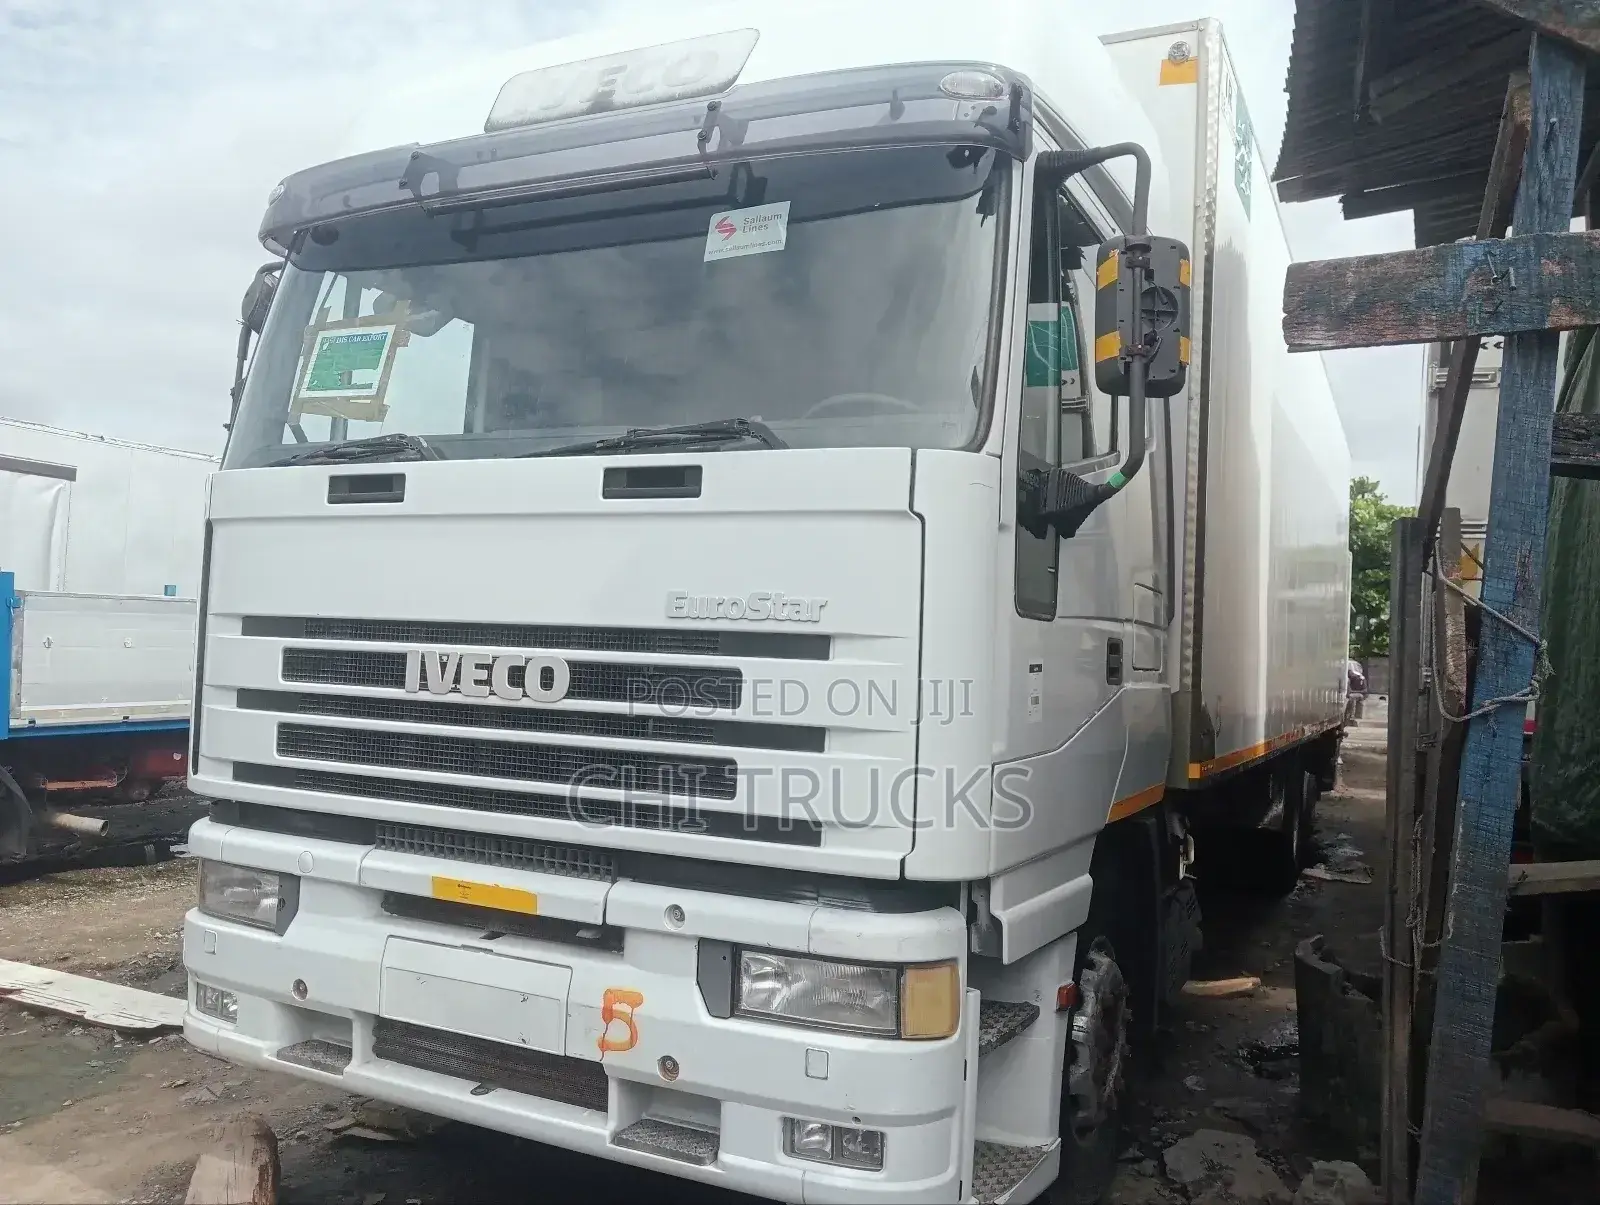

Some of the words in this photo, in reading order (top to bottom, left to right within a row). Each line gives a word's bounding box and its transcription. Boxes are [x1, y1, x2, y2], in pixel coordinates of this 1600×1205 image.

[743, 213, 782, 225] Sallaum
[742, 223, 769, 233] Lines
[348, 335, 361, 343] CAR
[361, 333, 387, 342] EXPORT
[667, 590, 828, 622] EuroStar
[405, 650, 570, 703] IVECO
